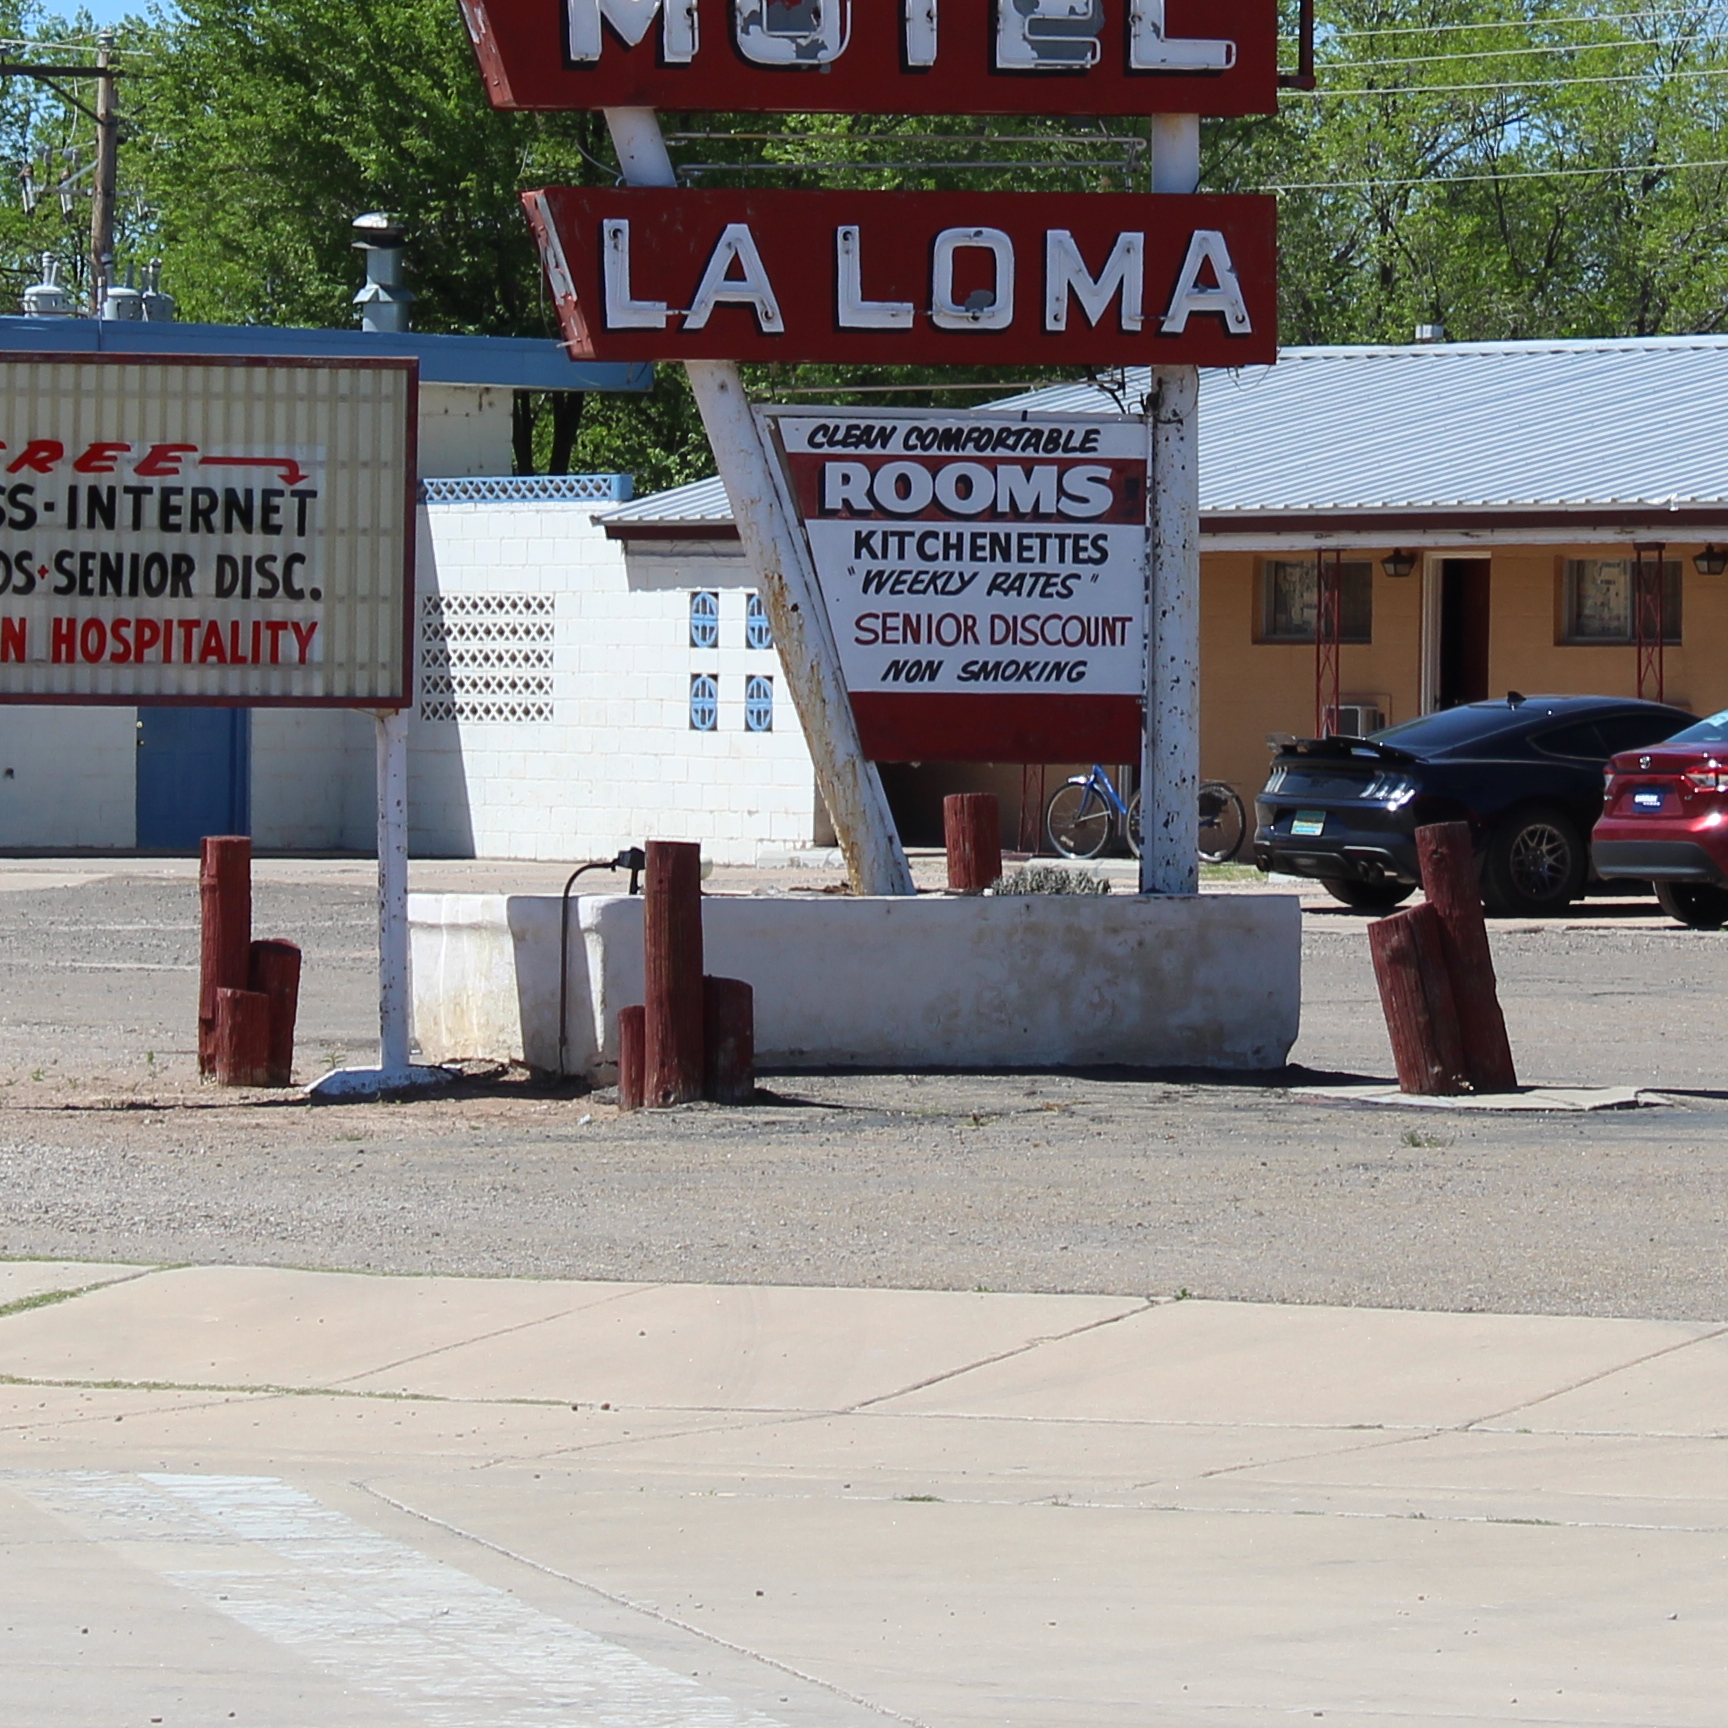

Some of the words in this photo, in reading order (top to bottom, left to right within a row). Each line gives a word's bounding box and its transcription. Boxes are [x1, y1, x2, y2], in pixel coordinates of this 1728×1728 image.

[603, 218, 784, 333] LA
[837, 224, 1252, 334] LOMA
[807, 423, 897, 450] CLEAN
[902, 425, 1101, 454] COMFORTABLE
[819, 460, 1114, 518] ROOMS
[854, 529, 1110, 565] KITCHENETTES
[53, 550, 195, 599] SENIOR
[215, 552, 323, 601] DISC.
[51, 617, 319, 666] HOSPITALITY
[854, 612, 980, 647] SENIOR
[990, 614, 1133, 647] DISCOUNT
[881, 659, 943, 683] NON
[956, 659, 1088, 684] SMOKING
